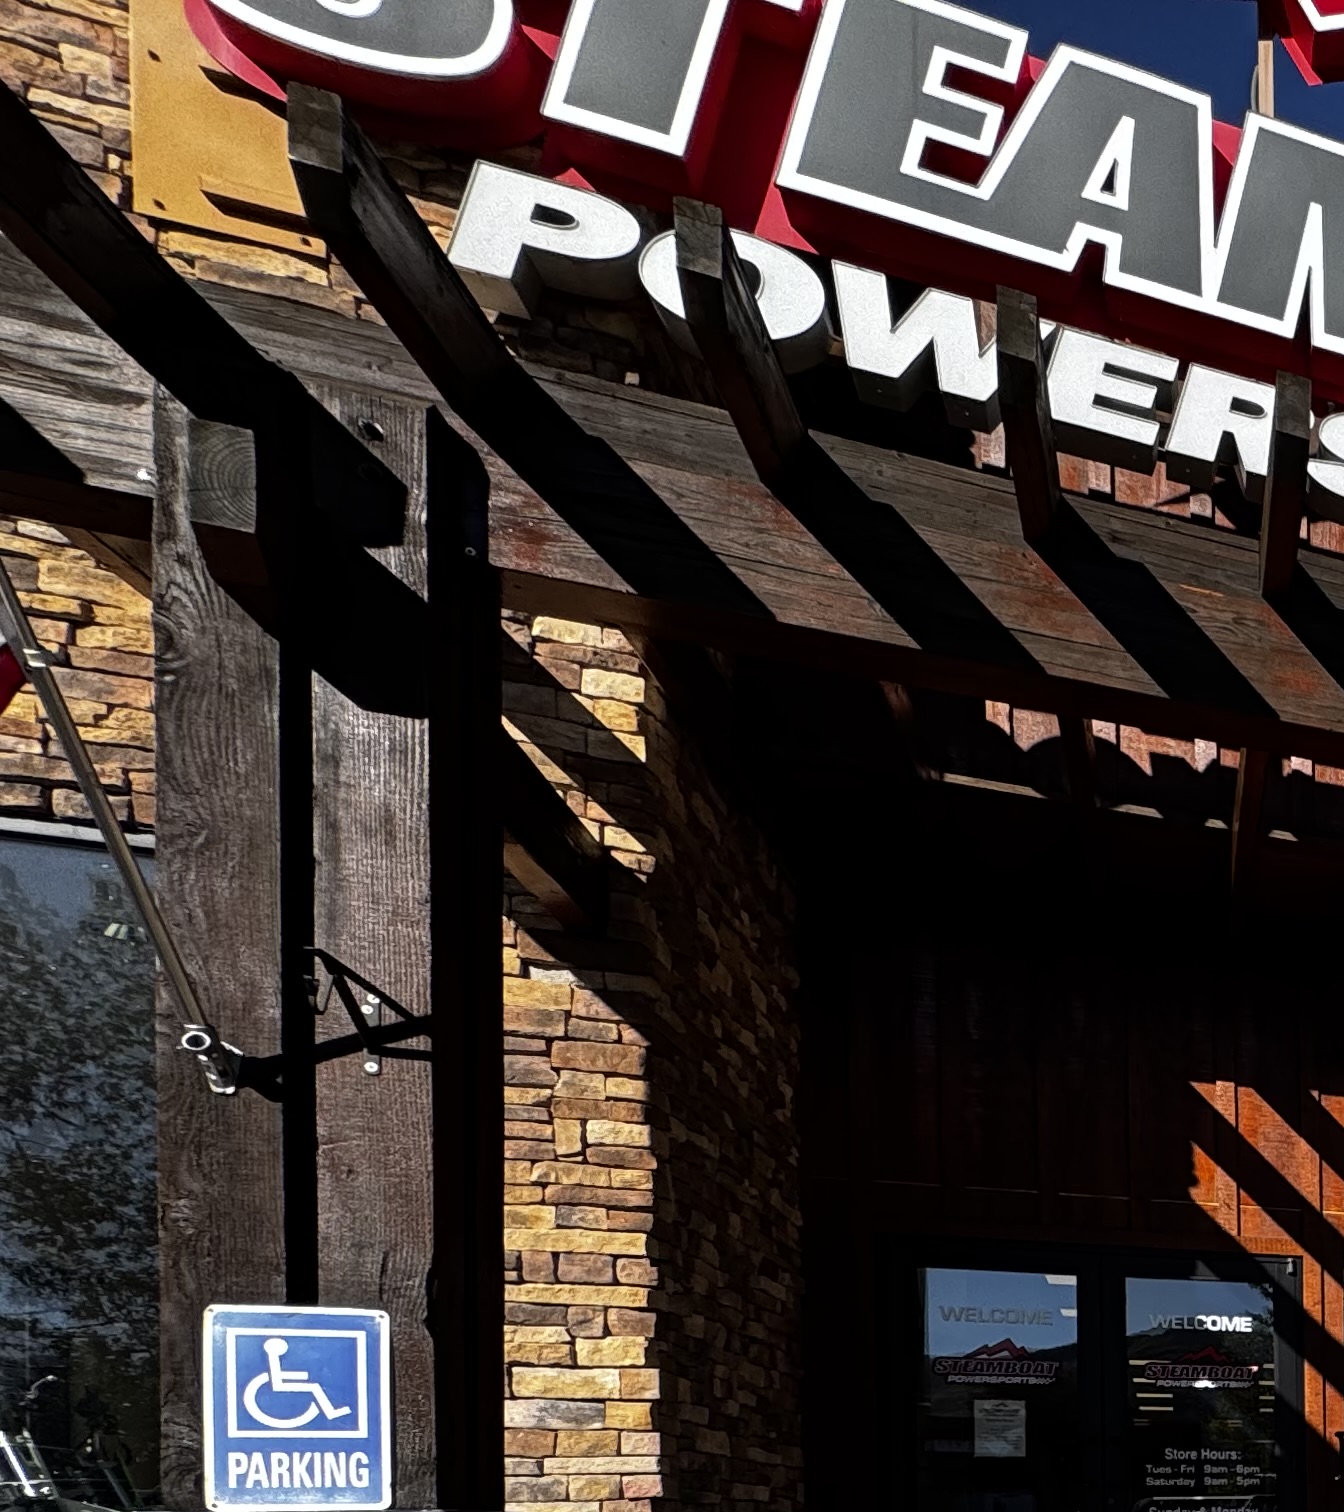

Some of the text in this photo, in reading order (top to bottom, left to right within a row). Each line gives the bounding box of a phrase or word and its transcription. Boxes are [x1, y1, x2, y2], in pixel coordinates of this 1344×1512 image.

[939, 1306, 1053, 1326] WELCOME
[1149, 1314, 1253, 1332] WELCOME
[934, 1359, 1059, 1376] STEAMBOAT
[1144, 1364, 1259, 1380] STEAMBOAT
[1165, 1448, 1242, 1460] Store Hours:
[228, 1452, 370, 1489] PARKING
[1181, 1464, 1195, 1474] Fri
[1146, 1477, 1196, 1488] Saturday
